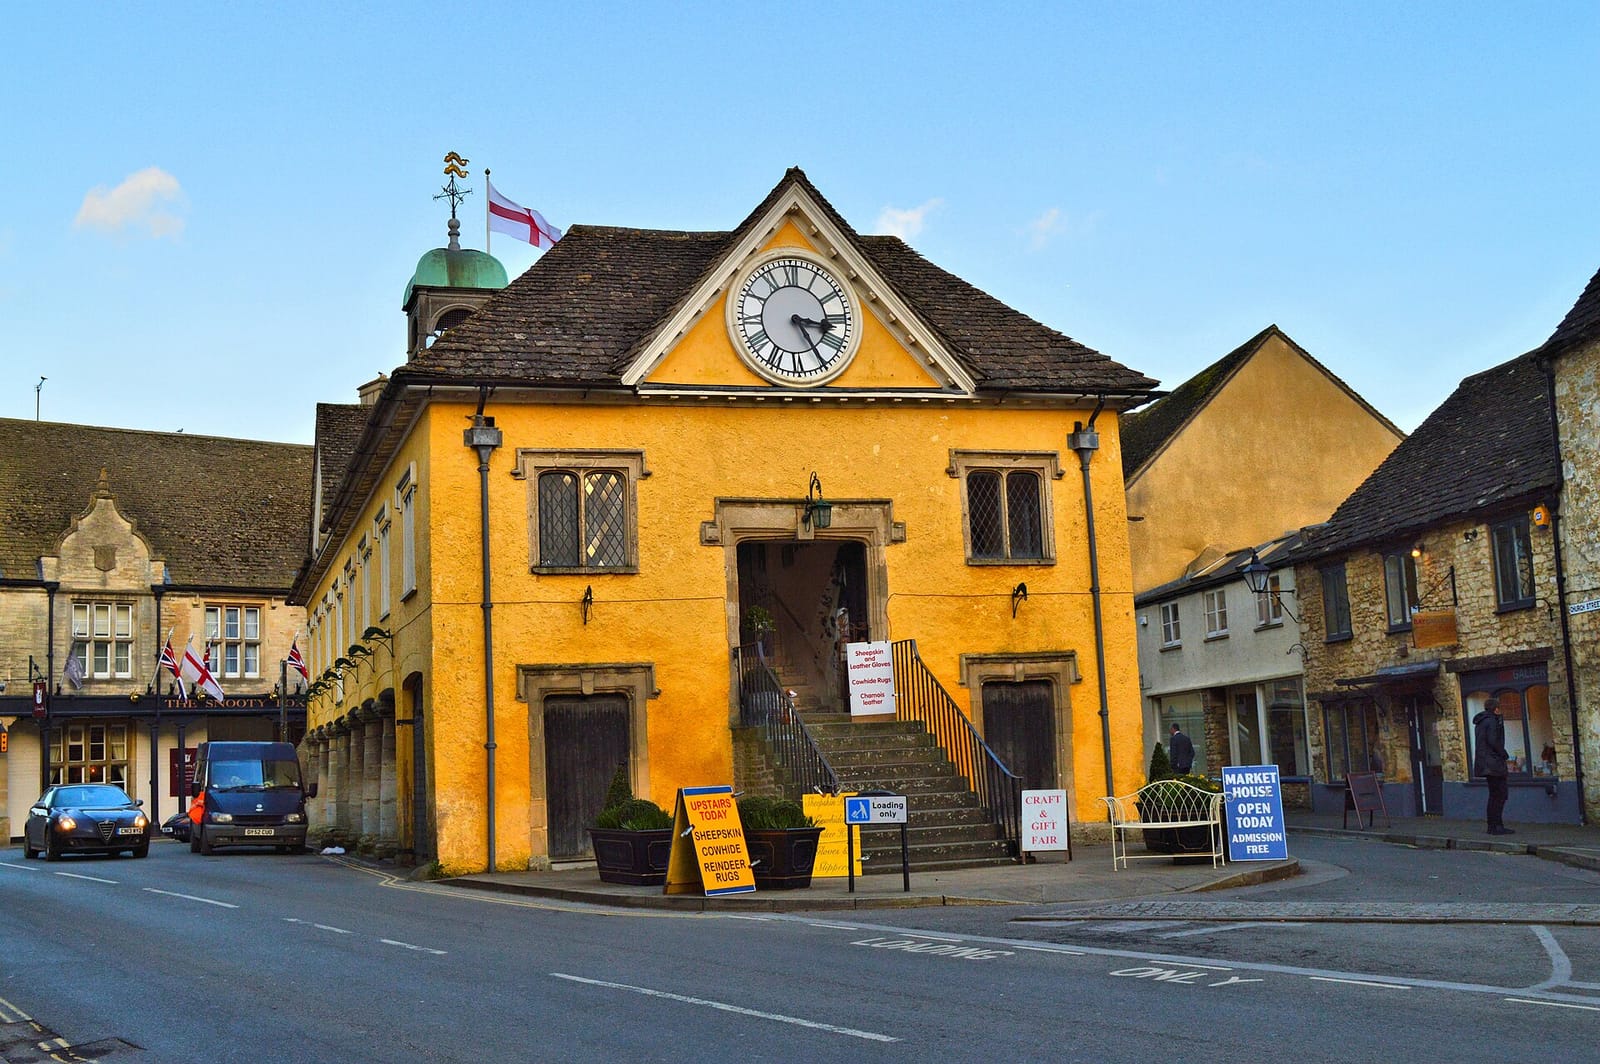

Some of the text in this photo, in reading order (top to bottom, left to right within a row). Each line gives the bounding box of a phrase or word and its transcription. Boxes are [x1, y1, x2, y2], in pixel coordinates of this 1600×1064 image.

[1570, 601, 1600, 613] CHURCH STREE
[855, 649, 884, 657] Sheepskin
[164, 699, 197, 708] THE
[206, 699, 265, 708] SNOOTY
[1225, 772, 1276, 785] MARKET
[1232, 786, 1273, 798] HOUSE
[690, 798, 732, 811] UPSTAIRS
[1025, 795, 1062, 805] CRAFT
[872, 802, 904, 810] Loading
[1237, 803, 1271, 815] OPEN
[699, 810, 727, 821] TODAY
[879, 810, 897, 818] only
[1039, 810, 1048, 818] &
[1031, 821, 1057, 831] GIFT
[1236, 816, 1274, 829] TODAY
[695, 828, 741, 841] SHEEPSKIN
[1031, 835, 1057, 845] FAIR
[1232, 832, 1282, 843] ADMISSION
[702, 844, 741, 856] COWHIDE
[1246, 844, 1269, 854] FREE
[704, 859, 746, 872] REINDEER
[716, 871, 740, 882] RUGS
[850, 937, 1015, 961] LOADING
[1109, 967, 1264, 988] ONLY
